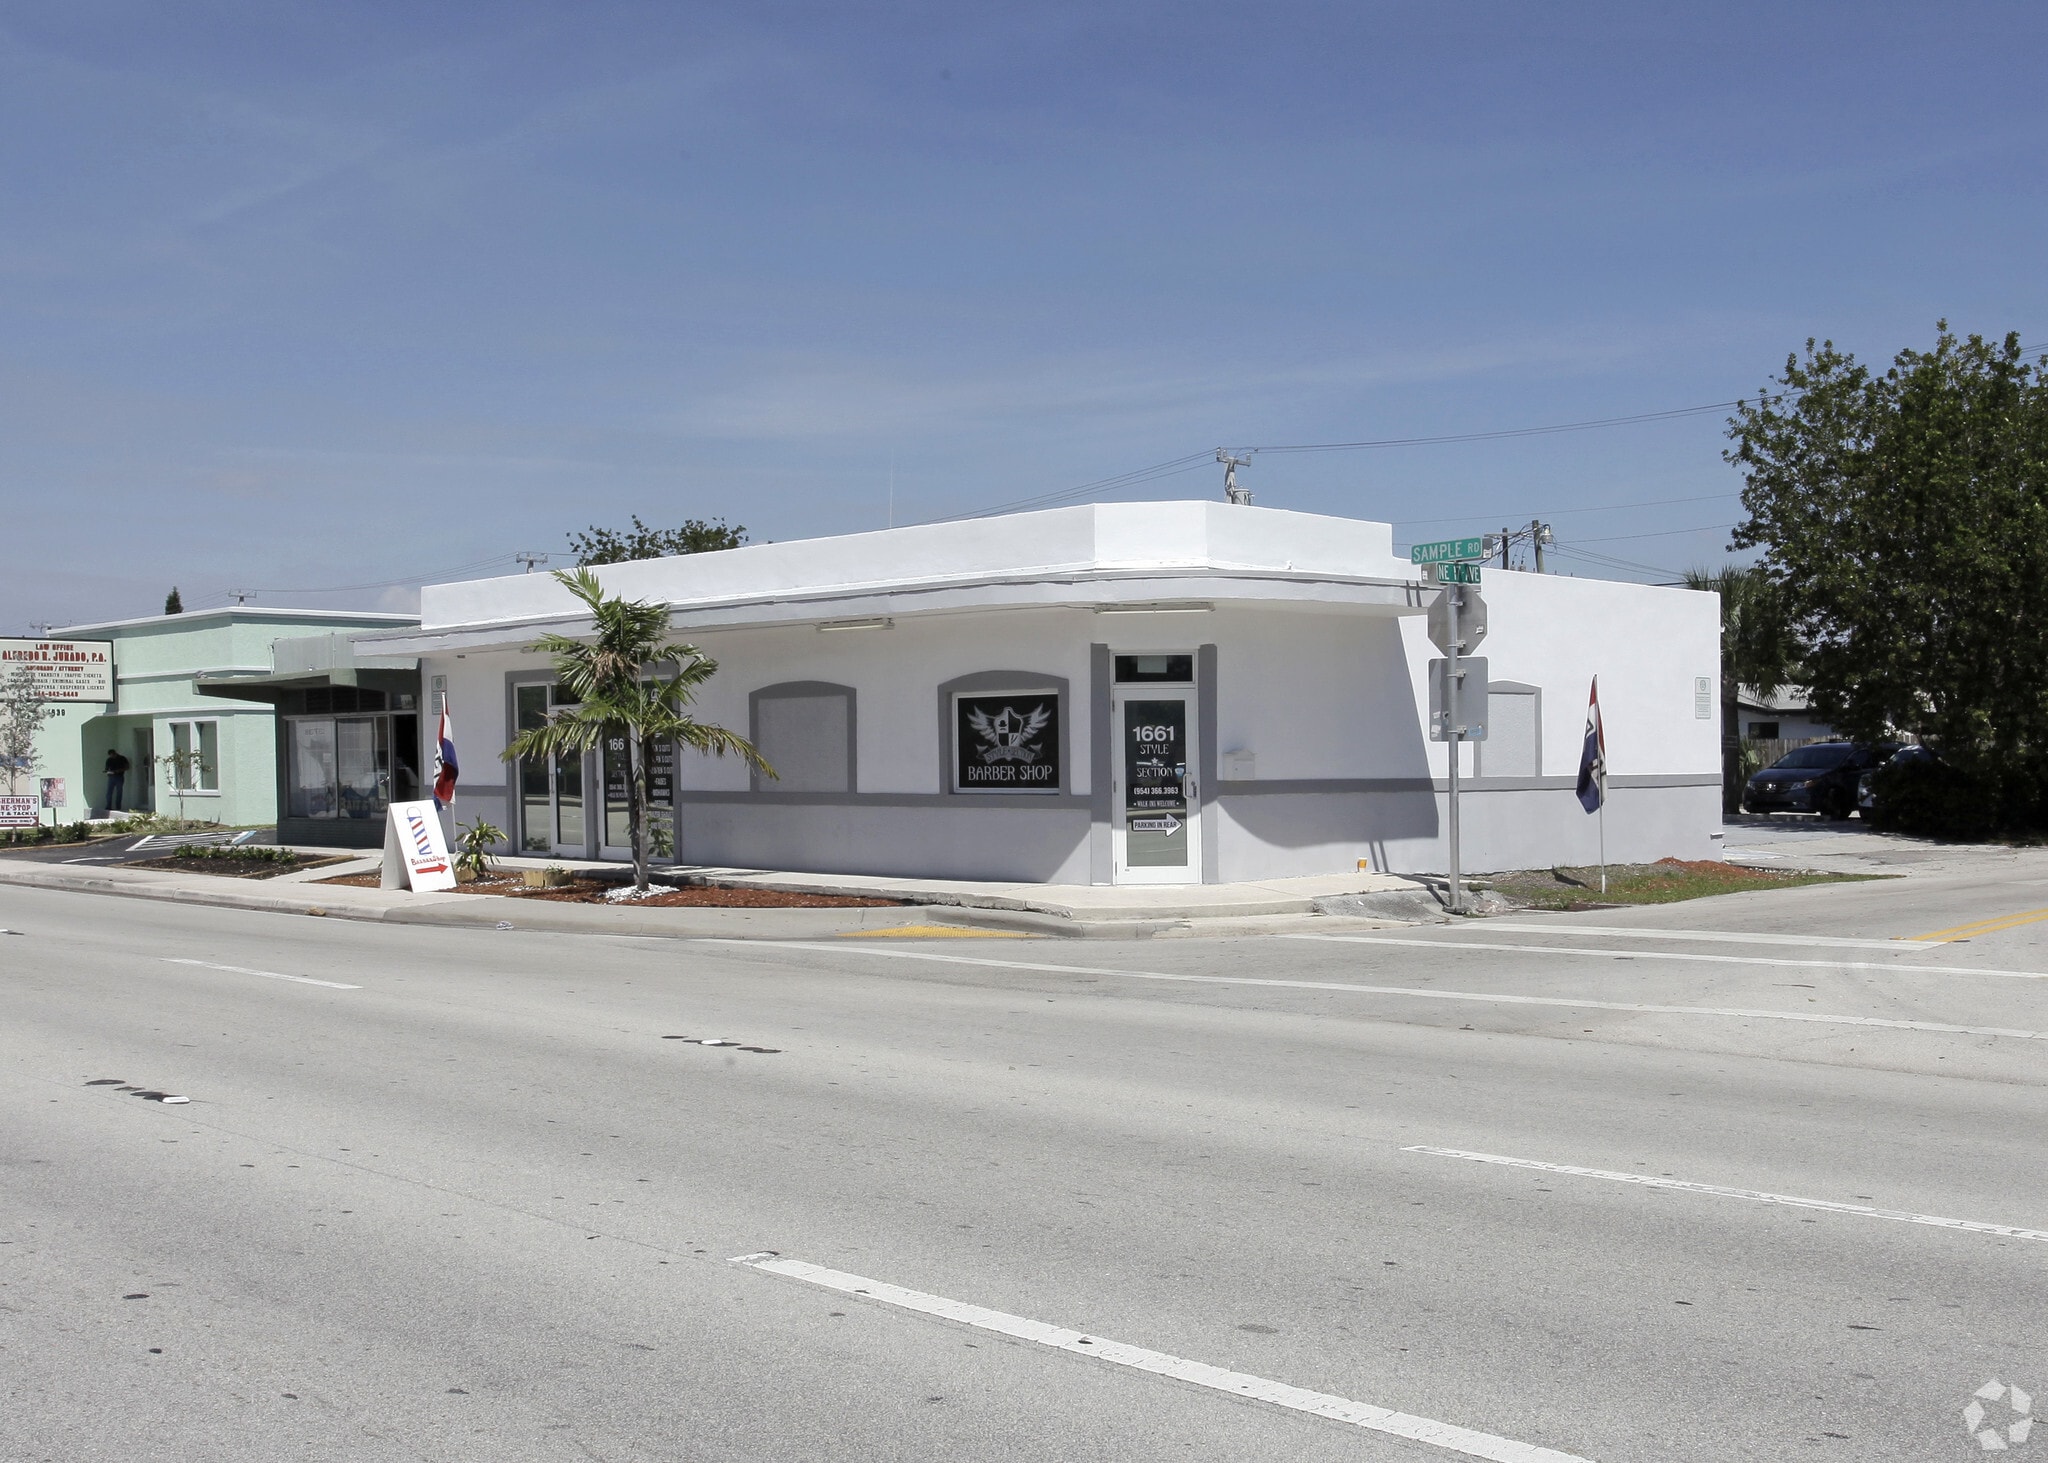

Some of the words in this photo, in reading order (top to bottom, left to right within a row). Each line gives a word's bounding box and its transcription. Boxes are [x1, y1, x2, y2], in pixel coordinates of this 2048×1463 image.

[1413, 541, 1463, 562] SAMPLE
[1467, 542, 1480, 554] RD
[1438, 565, 1450, 580] NE
[1465, 566, 1480, 582] AVE
[35, 643, 50, 651] LAW
[2, 650, 40, 661] ALFREDO
[53, 651, 90, 663] JURADO,
[91, 652, 107, 663] P.A.
[1132, 725, 1175, 742] 1661
[608, 737, 625, 751] 166
[1139, 743, 1170, 755] STYLE
[967, 765, 1016, 781] BARBER
[1019, 765, 1053, 780] SHOP
[1136, 767, 1173, 778] SECTION
[1133, 787, 1150, 795] (954)
[0, 797, 37, 805] HERMAN'S
[1134, 821, 1156, 829] PARKING
[1156, 821, 1163, 829] IN
[1163, 821, 1178, 829] REAR
